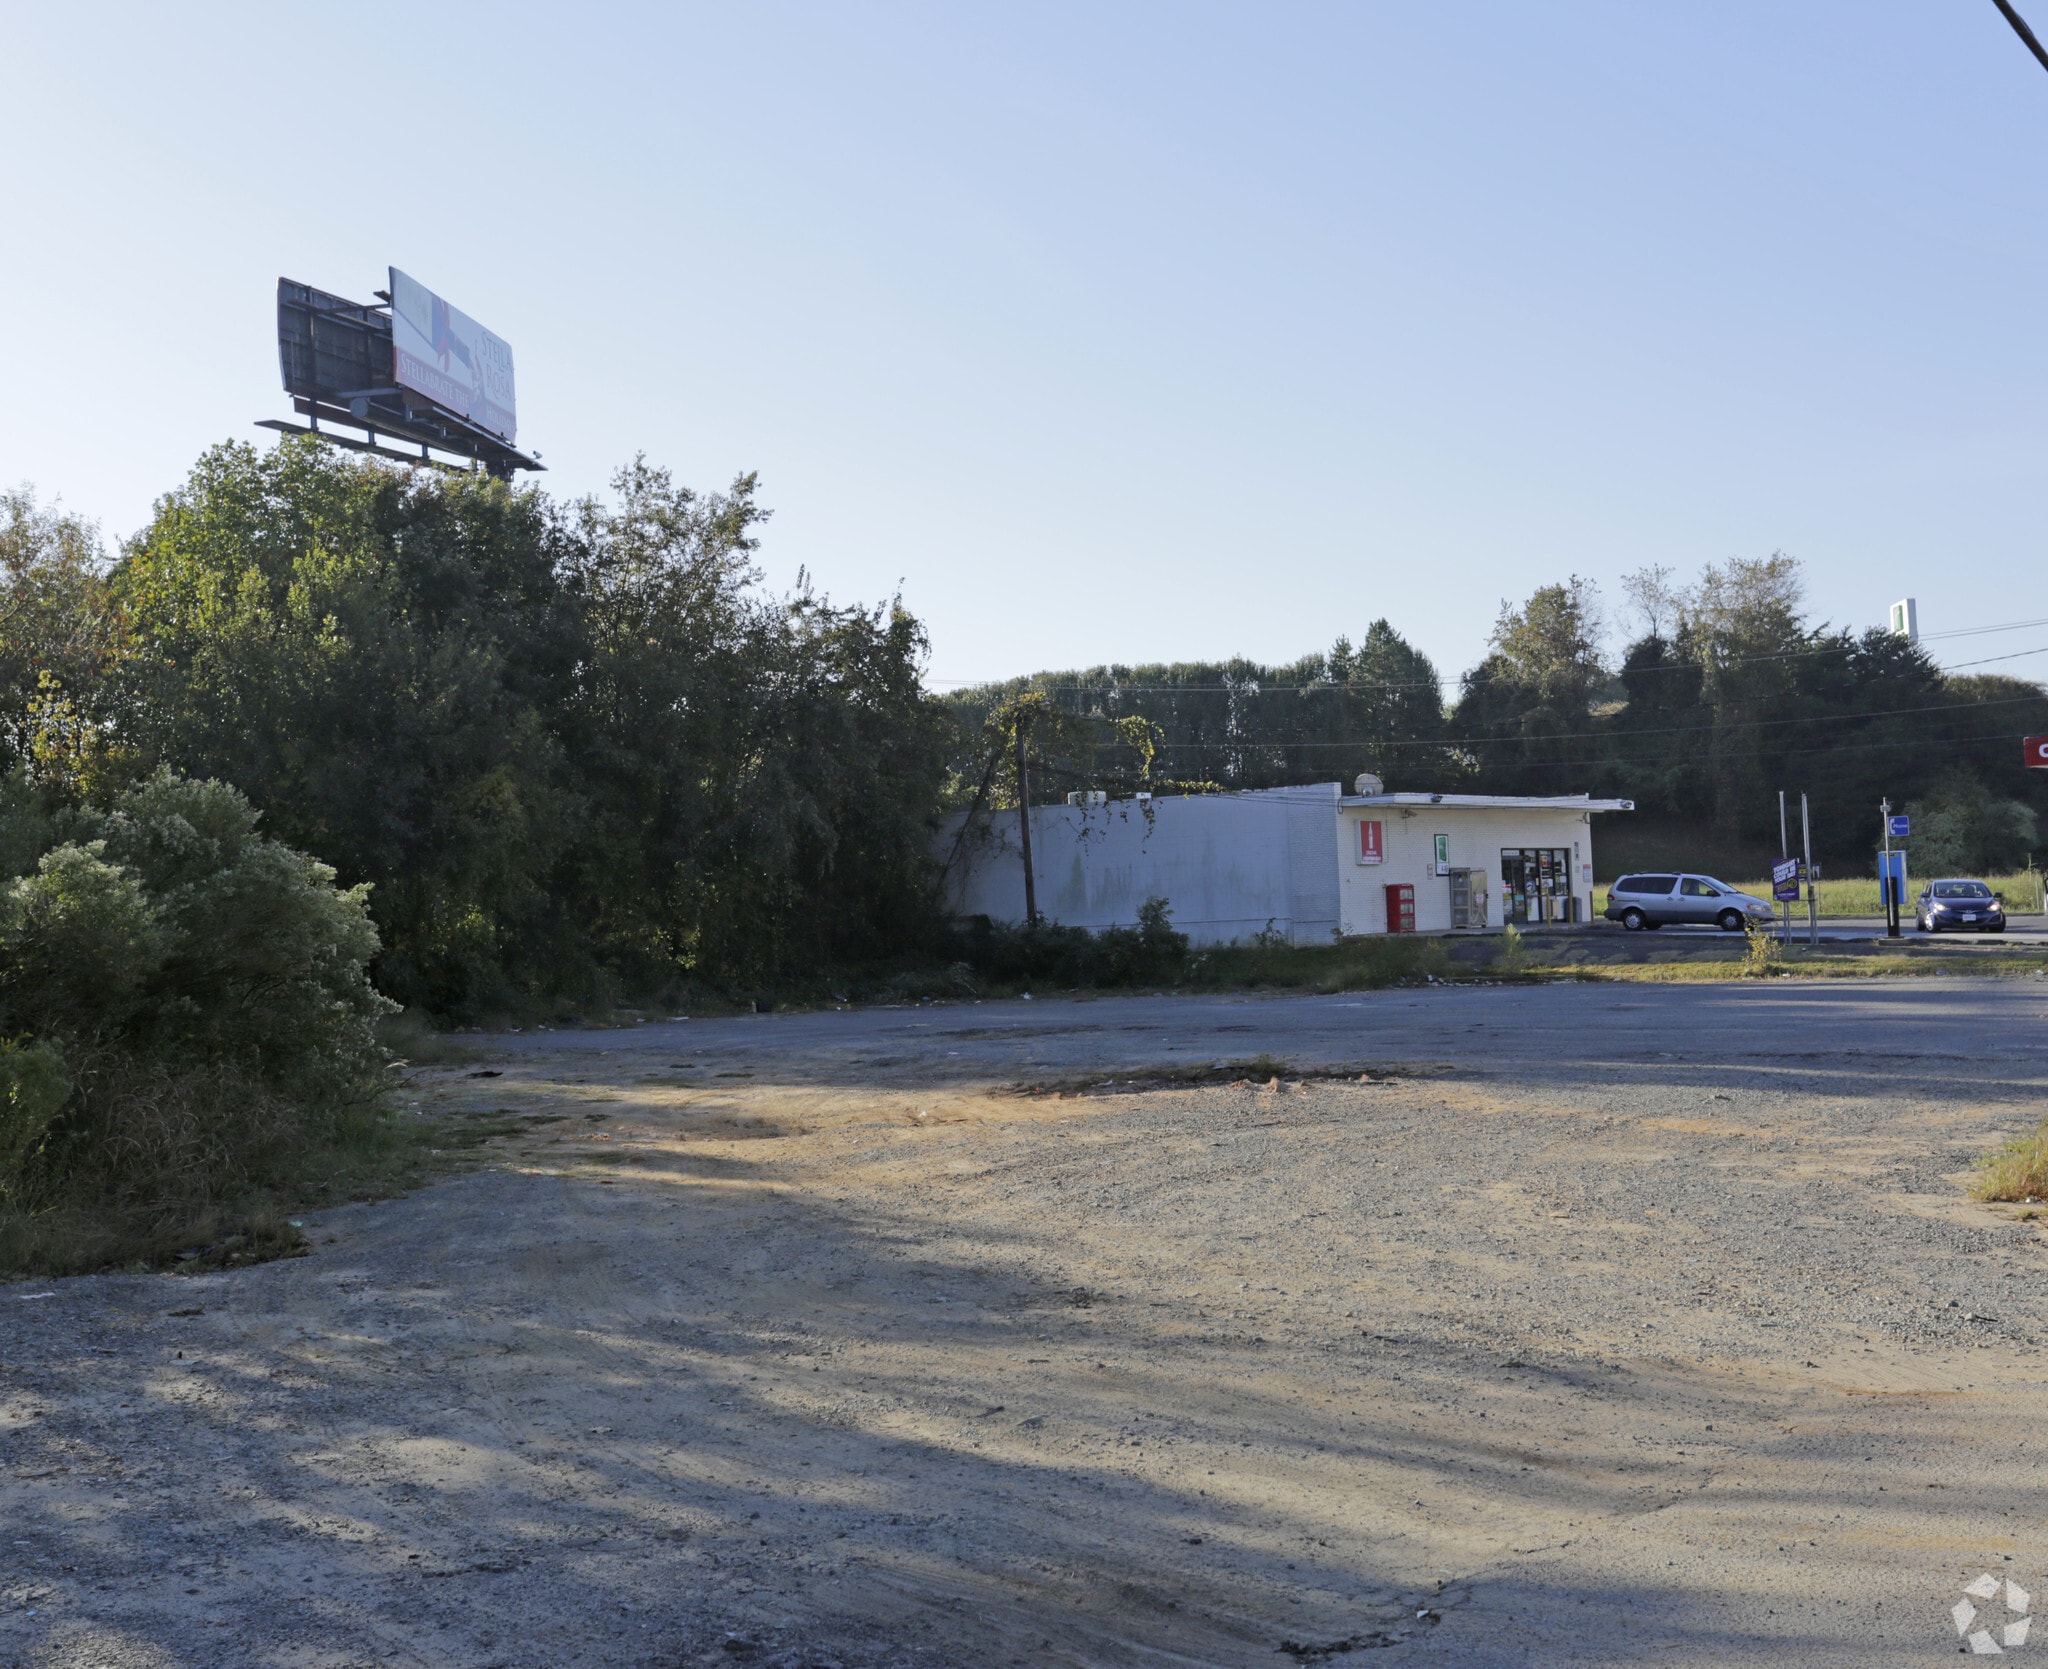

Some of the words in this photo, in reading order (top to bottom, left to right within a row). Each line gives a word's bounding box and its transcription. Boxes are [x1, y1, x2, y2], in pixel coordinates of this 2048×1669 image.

[482, 331, 513, 373] STELLA
[400, 353, 454, 401] STELLABRATE
[455, 388, 470, 408] THE
[486, 363, 512, 400] ROSA
